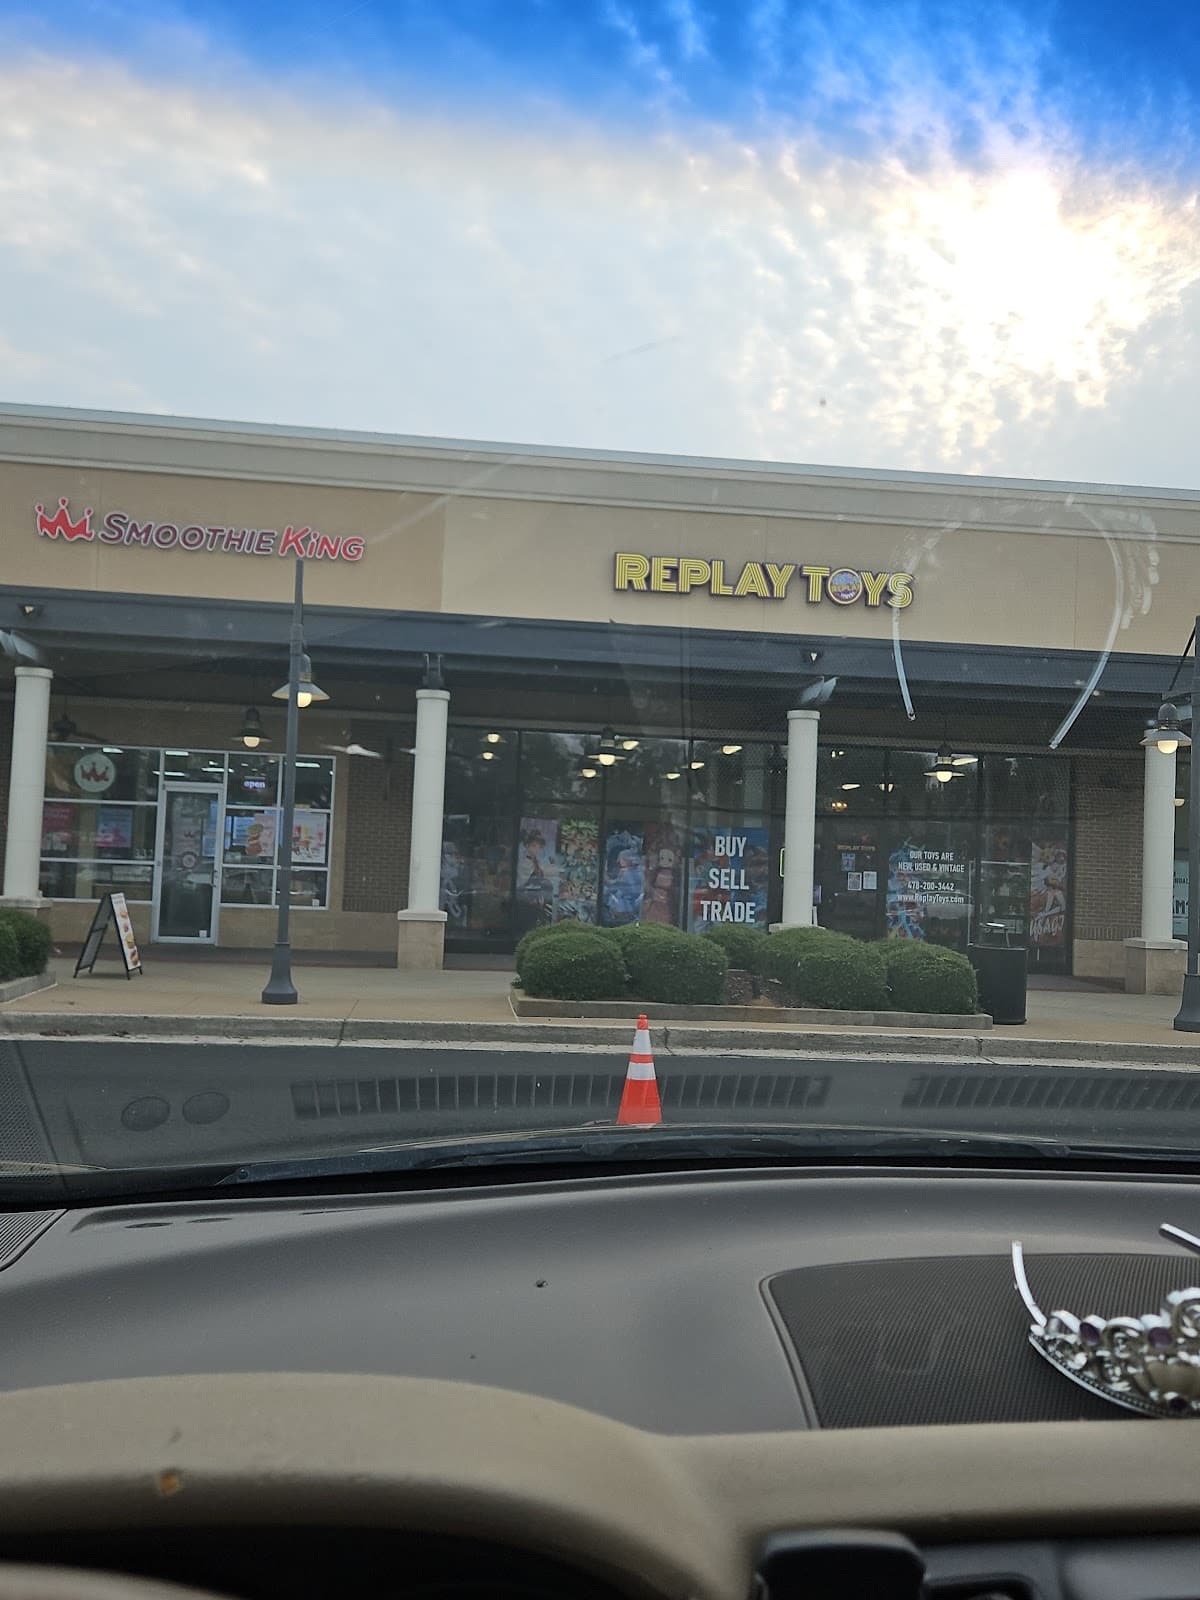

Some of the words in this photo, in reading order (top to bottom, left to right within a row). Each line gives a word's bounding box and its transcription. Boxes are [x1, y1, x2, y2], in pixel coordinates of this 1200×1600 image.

[99, 512, 277, 555] SMOOTHIE
[614, 552, 796, 599] REPLAY
[802, 564, 914, 609] TOYS
[714, 835, 747, 857] BUY
[909, 850, 922, 860] OUR
[923, 850, 940, 860] TOYS
[940, 852, 954, 861] ARE
[708, 867, 750, 890] SELL
[914, 862, 931, 872] USED
[938, 863, 965, 873] VINTAGE
[700, 900, 756, 923] TRADE
